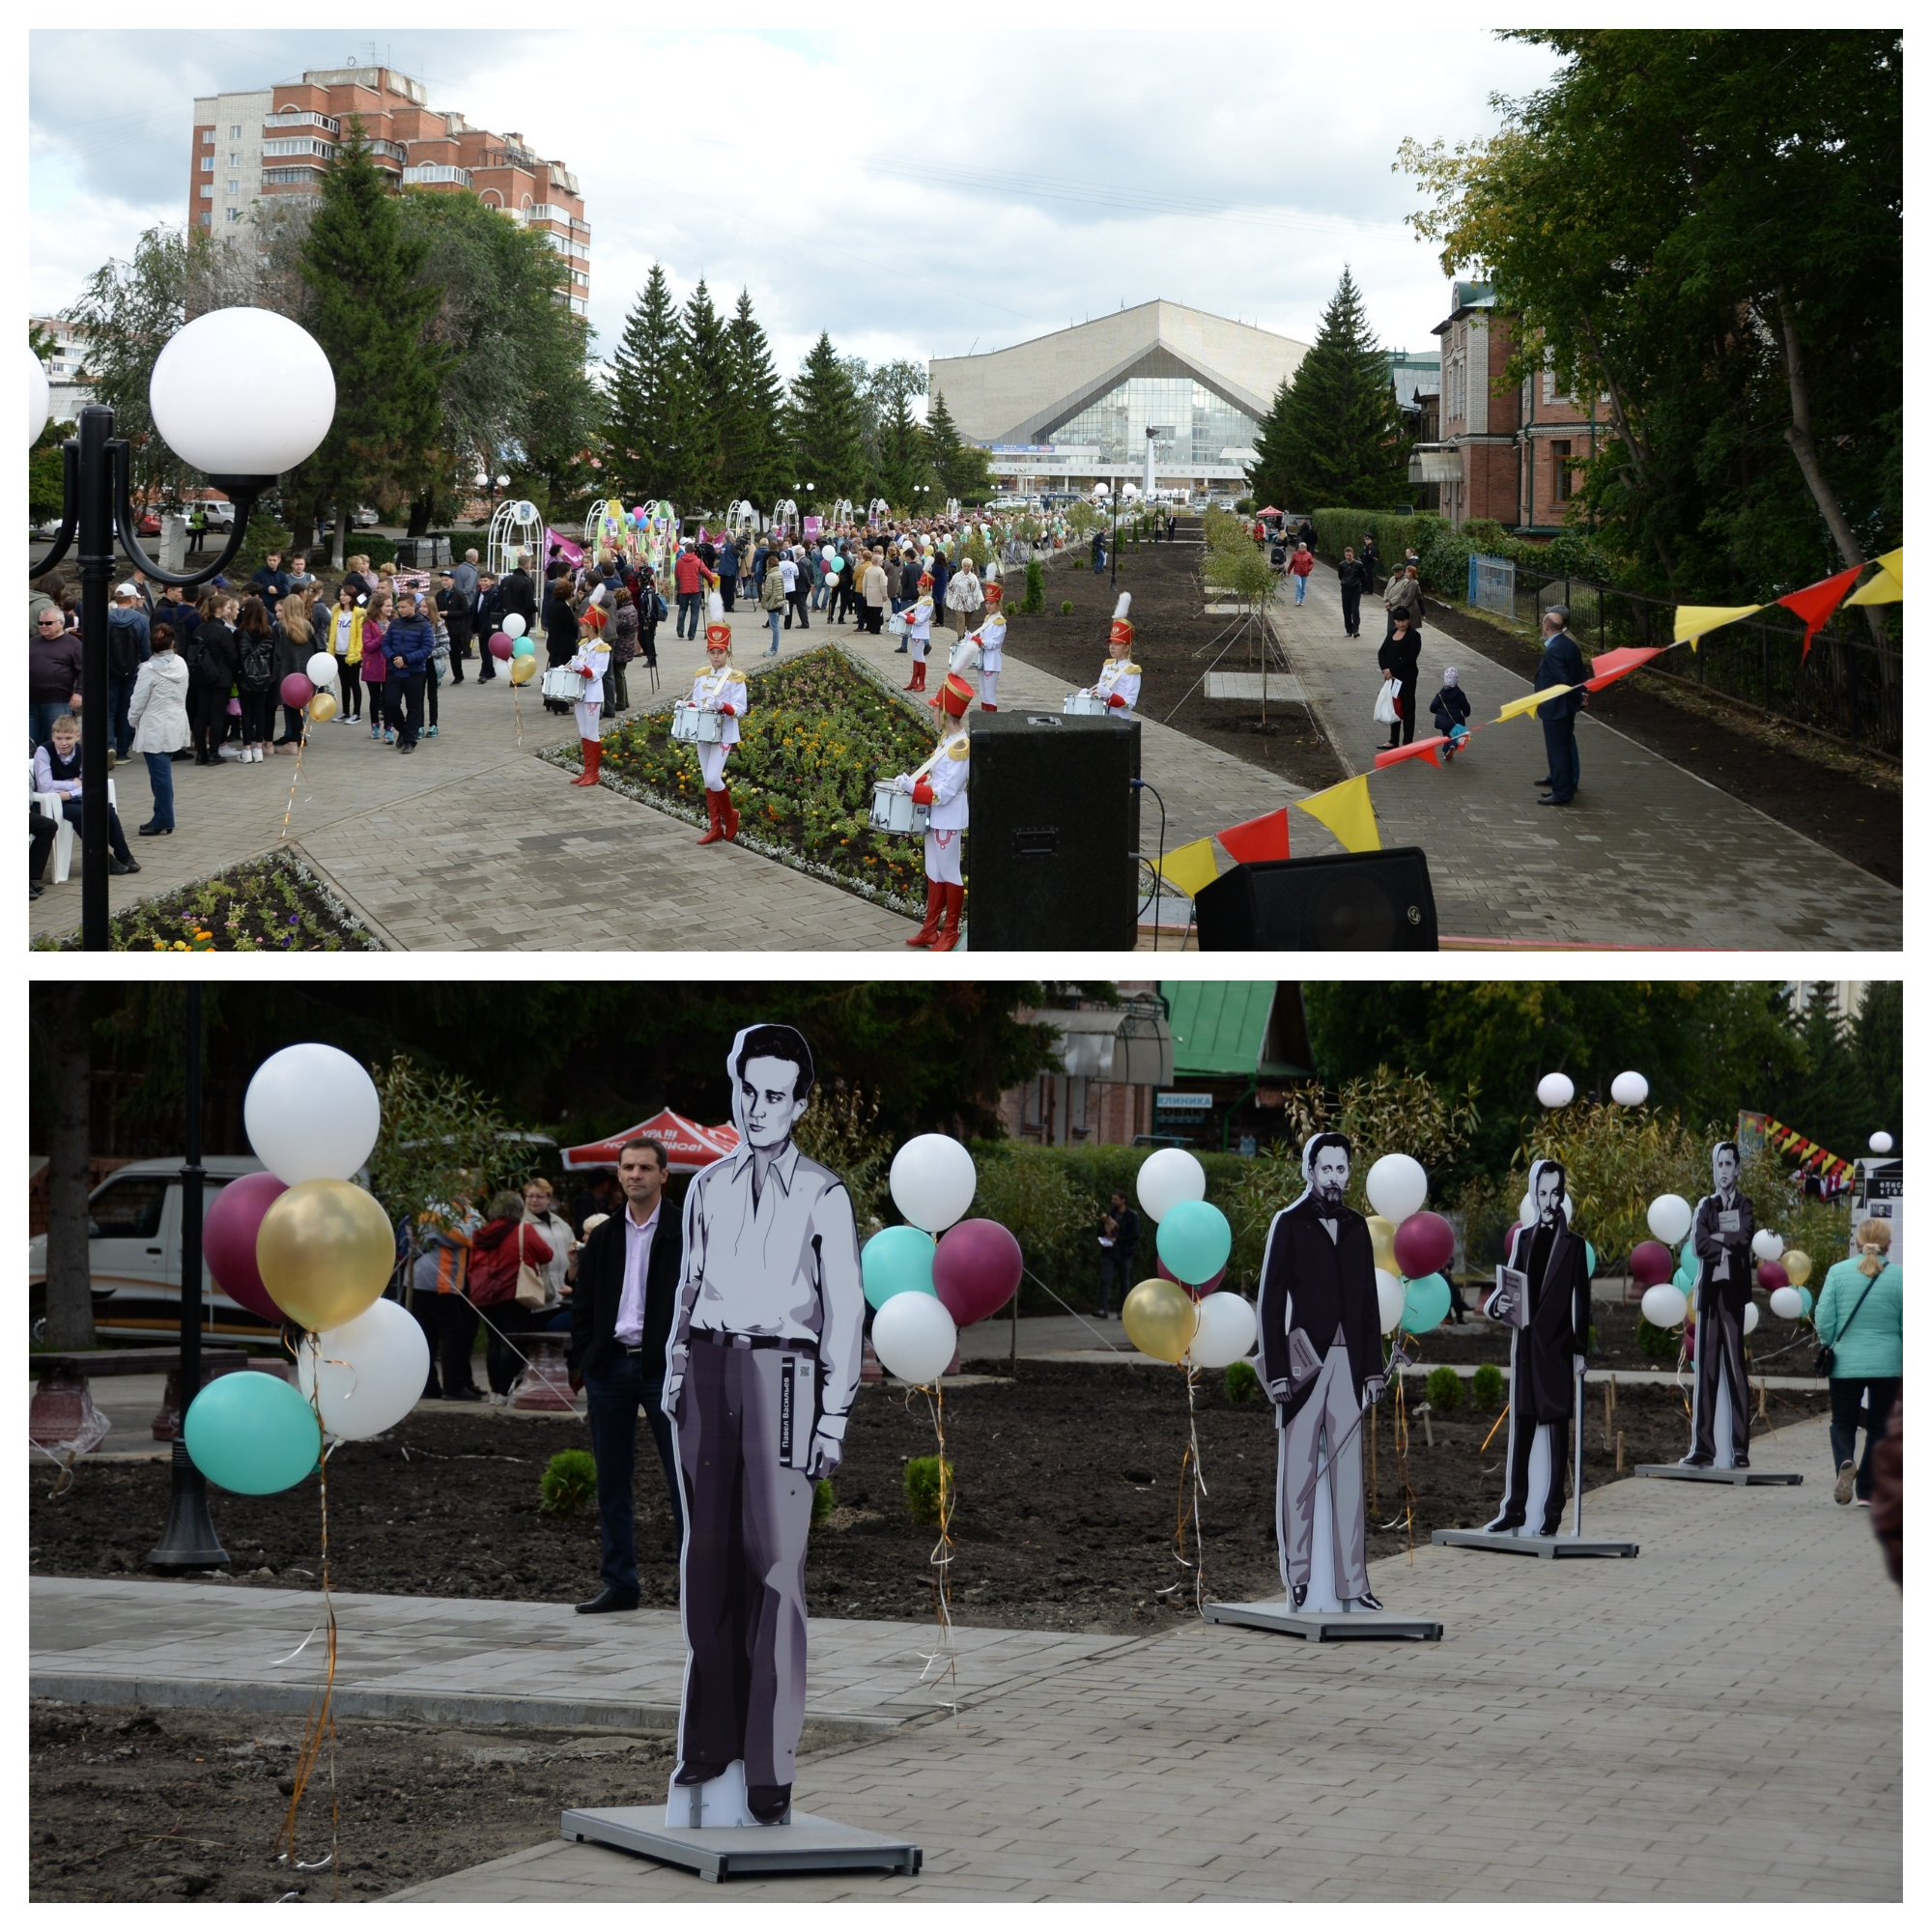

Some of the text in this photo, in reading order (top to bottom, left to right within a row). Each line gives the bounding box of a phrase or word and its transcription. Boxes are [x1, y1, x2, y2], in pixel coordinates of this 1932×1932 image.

[1157, 1096, 1210, 1105] КЛИНИКА
[781, 1377, 790, 1448] Павел Васильев
